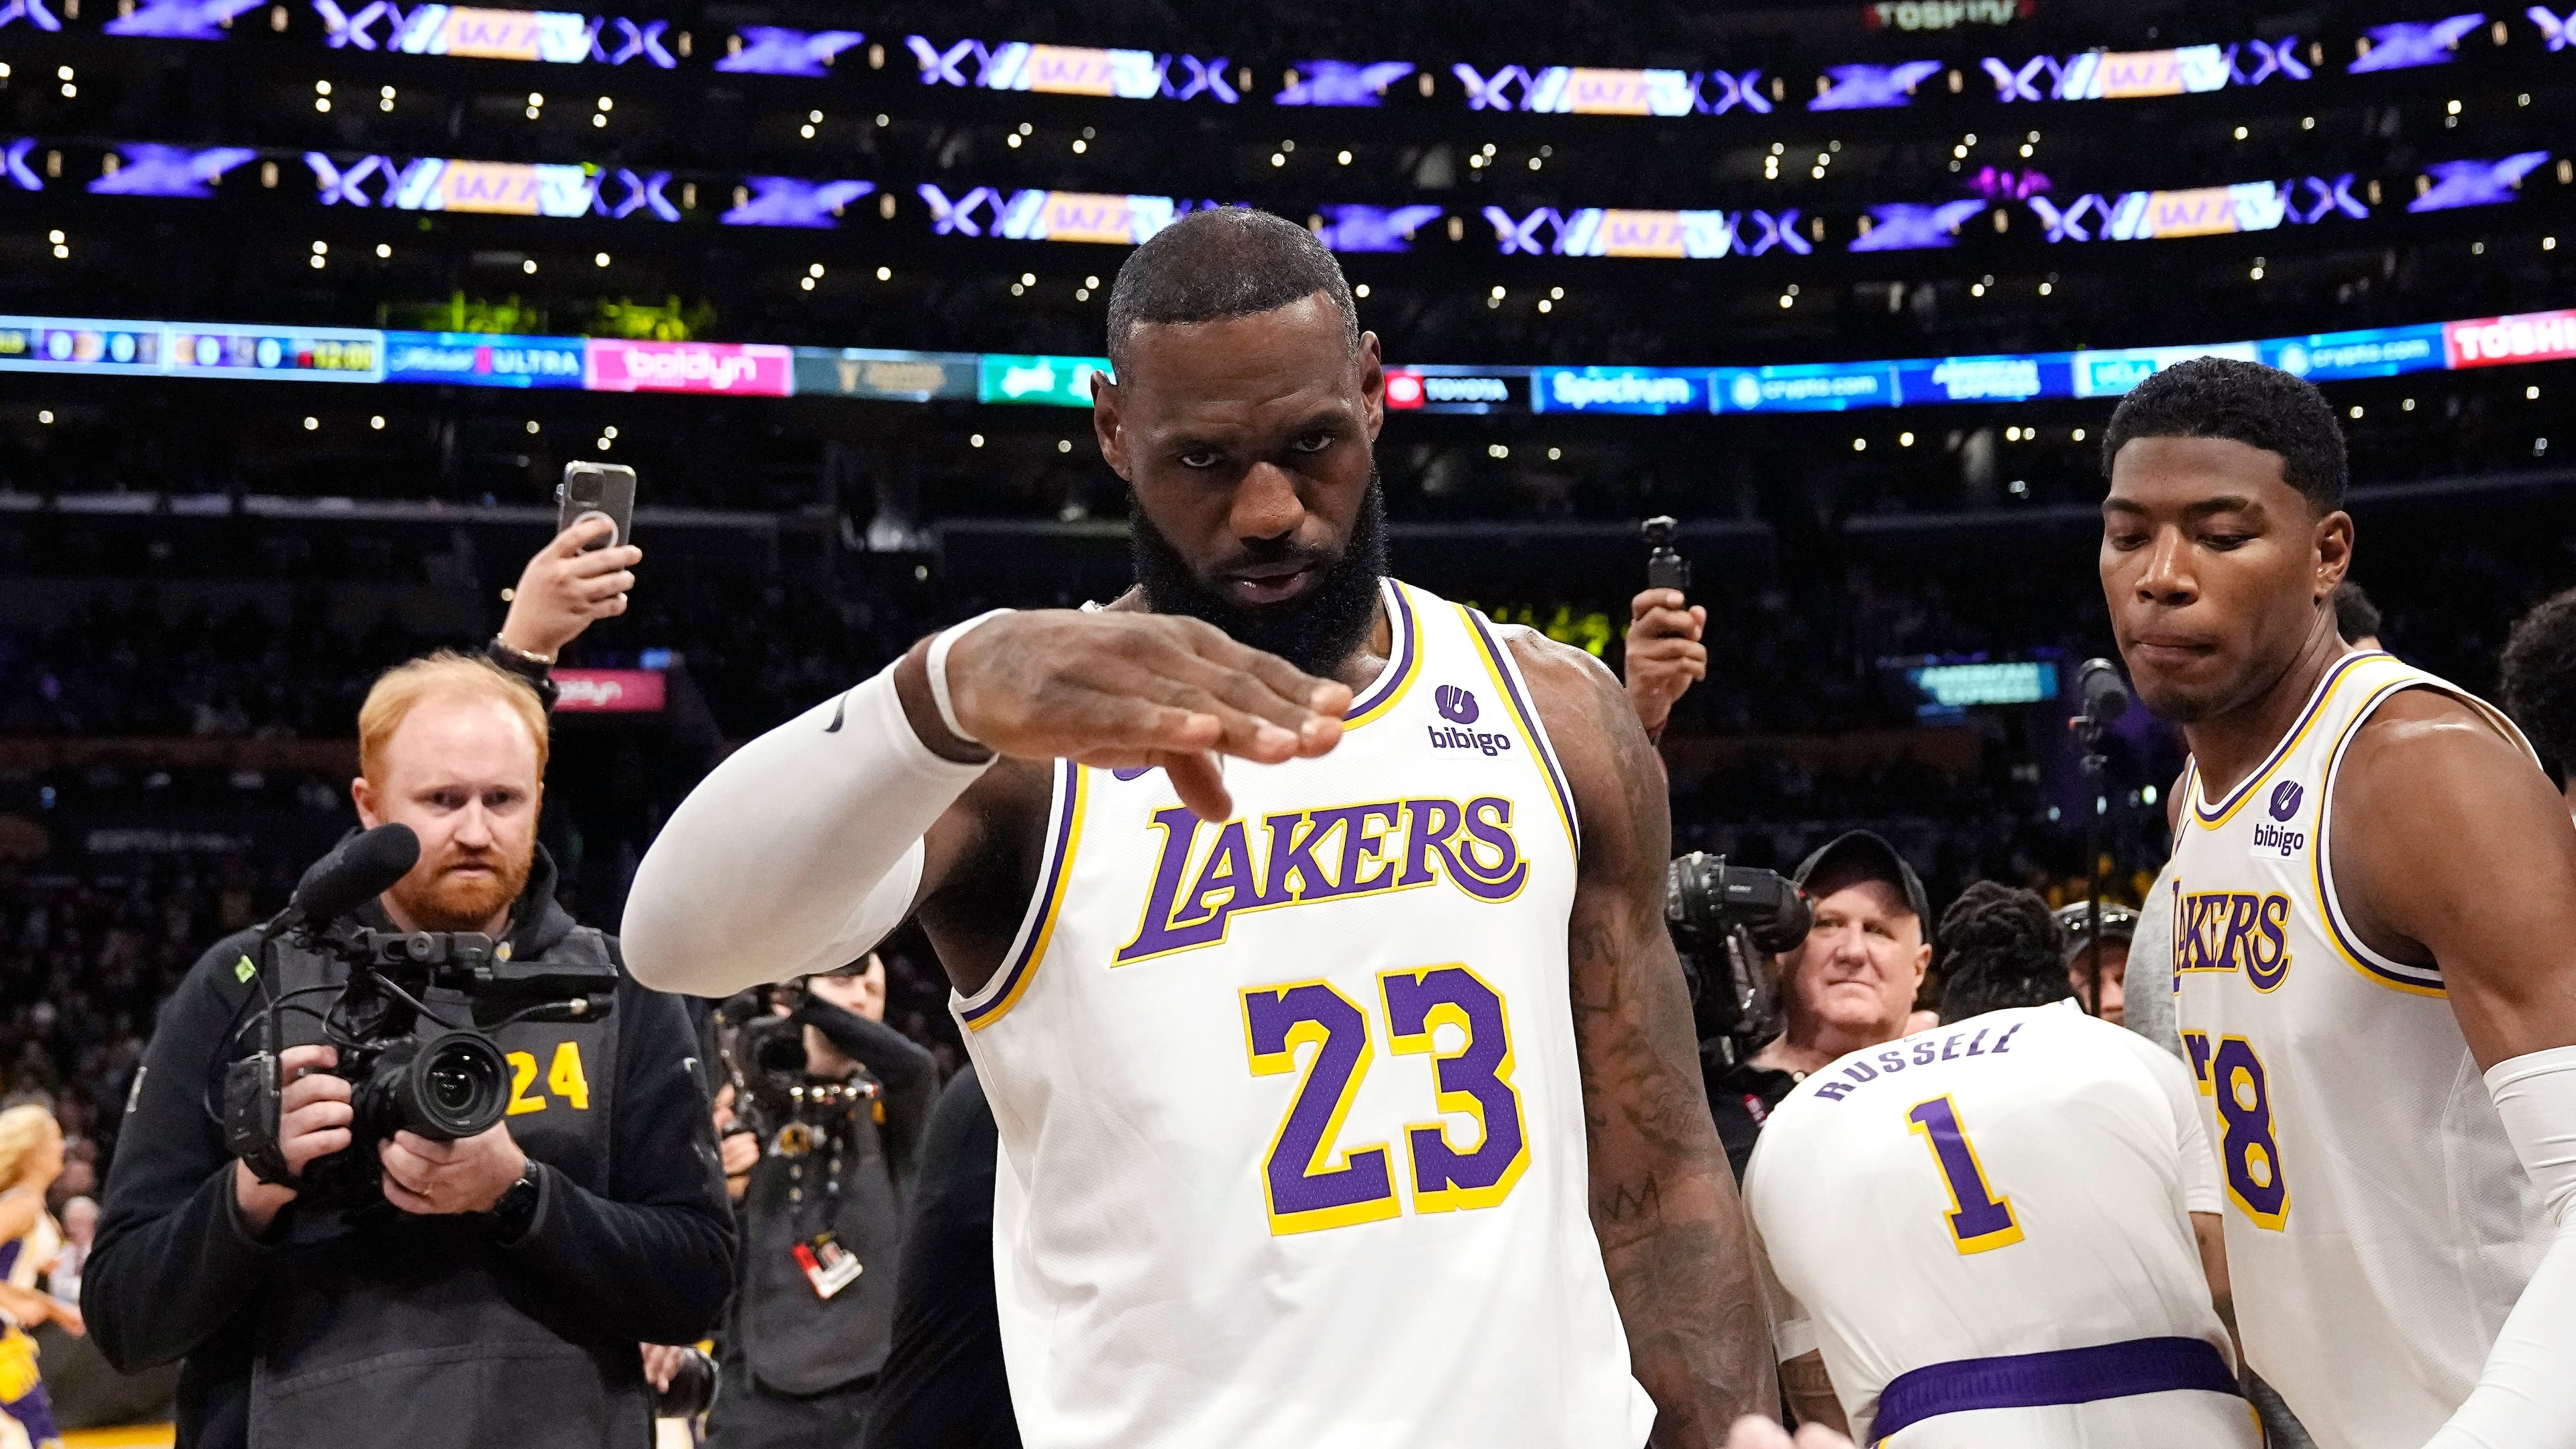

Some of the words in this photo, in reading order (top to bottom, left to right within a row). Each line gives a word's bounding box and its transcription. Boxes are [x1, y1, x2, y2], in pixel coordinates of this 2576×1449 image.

[493, 347, 580, 376] ULTRA
[623, 345, 757, 389] boldyn
[2312, 339, 2430, 368] crypto.com
[1424, 377, 1508, 401] TOYOTA
[1554, 370, 1690, 409] Spectrum
[1762, 376, 1877, 399] crypto.com
[1428, 726, 1511, 757] bibigo
[2254, 824, 2304, 857] bibigo
[1110, 793, 1532, 968] LAKERS
[505, 1040, 590, 1116] 24
[1814, 1022, 2025, 1102] RUSSELL
[1238, 961, 1532, 1236] 23
[1903, 1091, 2026, 1256] 1
